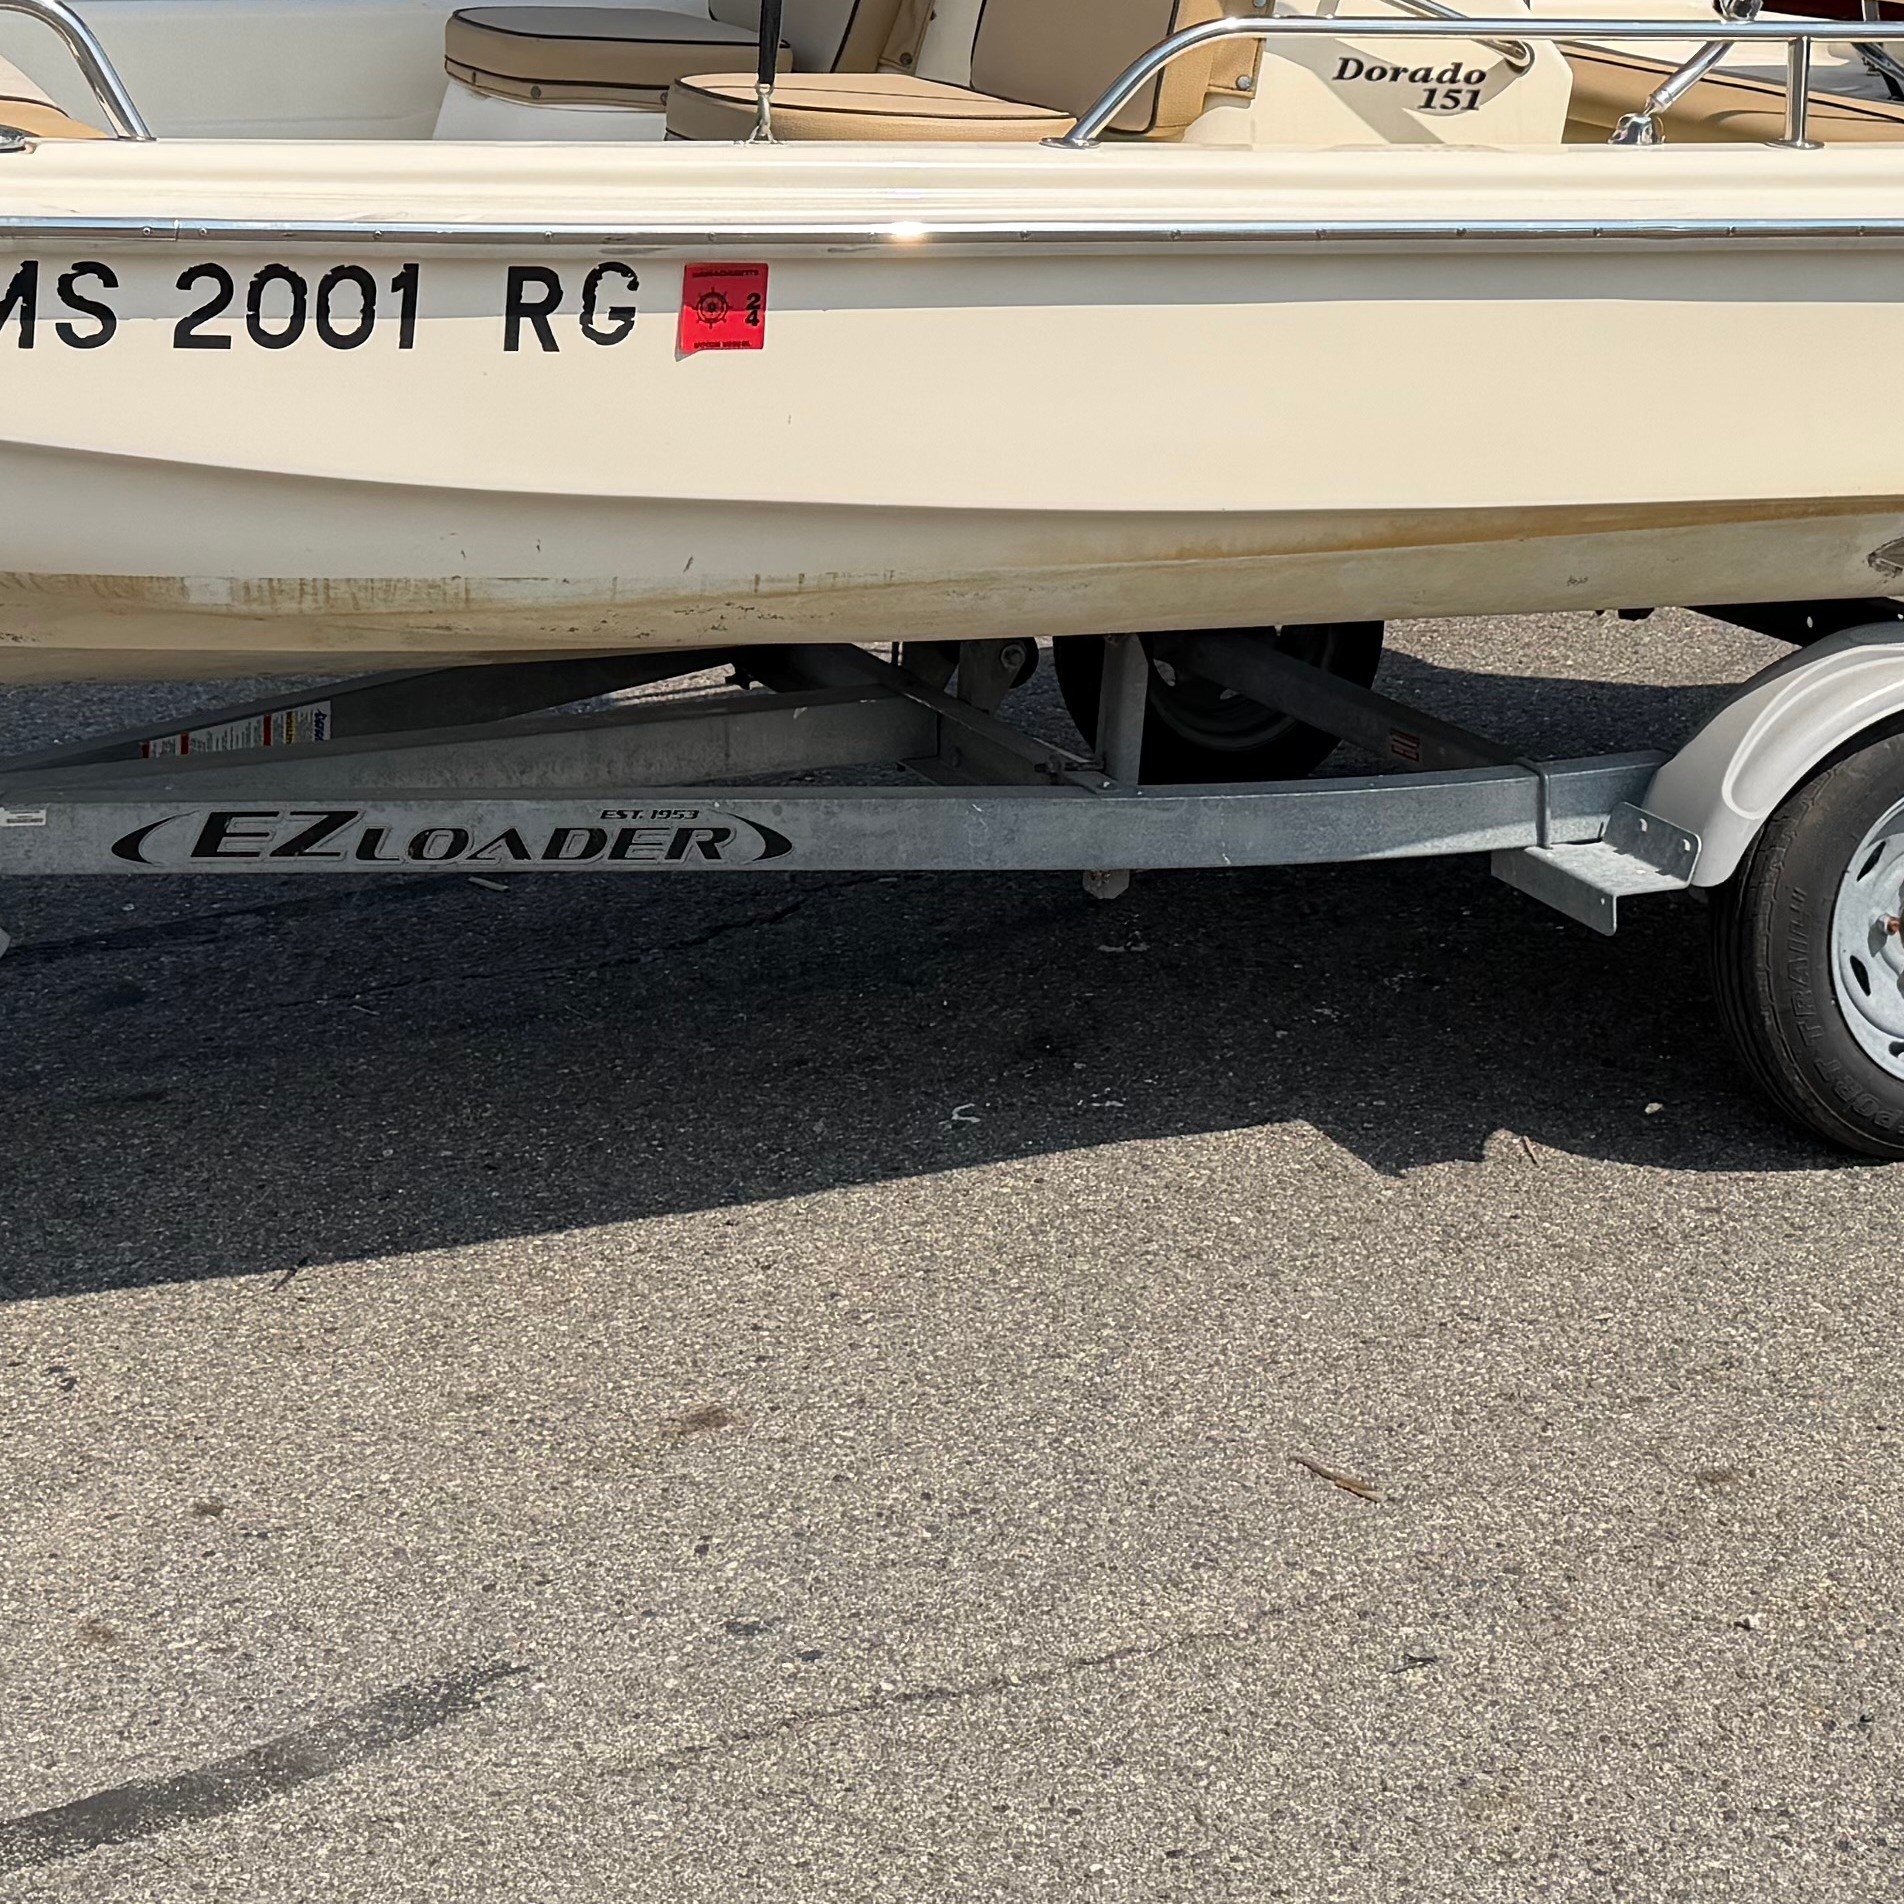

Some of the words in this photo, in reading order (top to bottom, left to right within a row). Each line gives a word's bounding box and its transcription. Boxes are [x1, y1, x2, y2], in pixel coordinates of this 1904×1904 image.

[1332, 56, 1487, 85] Dorado
[1417, 87, 1482, 111] 151
[173, 261, 420, 351] 2001
[504, 261, 639, 352] RG
[600, 809, 644, 820] EST.
[650, 809, 700, 820] 1953
